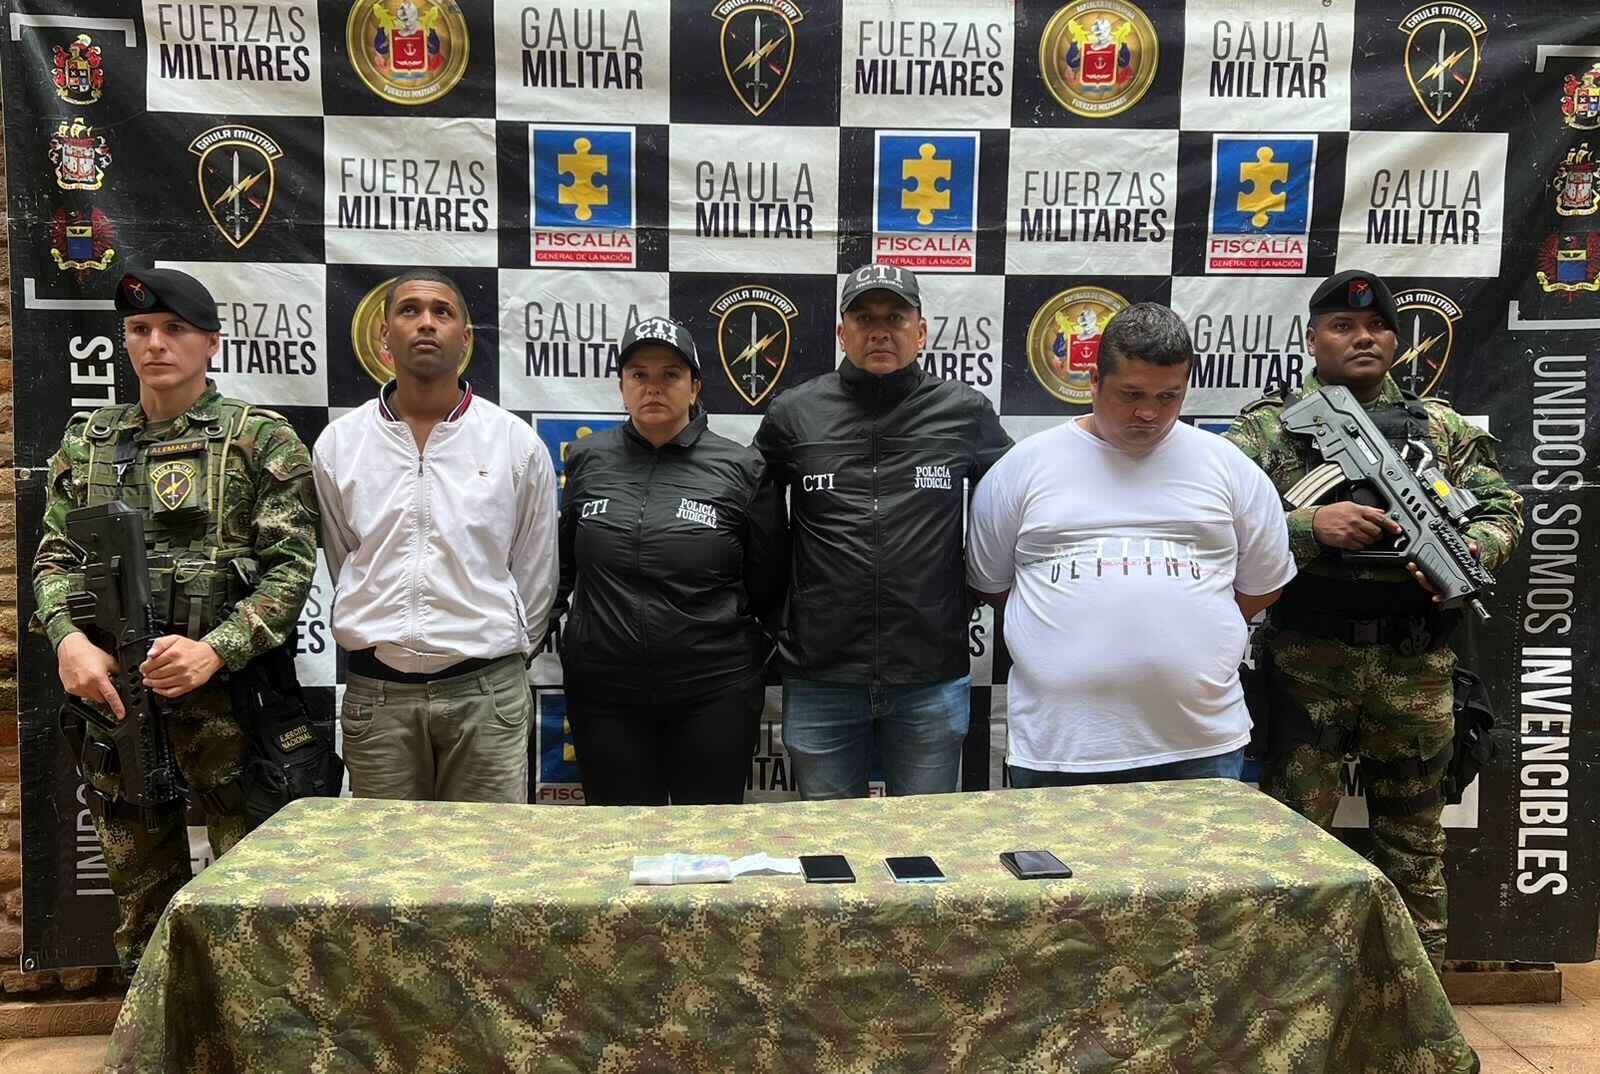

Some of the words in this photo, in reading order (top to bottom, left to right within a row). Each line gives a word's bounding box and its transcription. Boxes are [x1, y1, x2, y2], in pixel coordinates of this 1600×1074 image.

[159, 4, 306, 43] FUERZAS
[521, 6, 644, 51] GAULA
[1405, 6, 1440, 28] GAULA
[1441, 6, 1482, 30] MILITAR
[859, 20, 1003, 58] FUERZAS
[1213, 20, 1330, 62] GAULA
[160, 44, 311, 82] MILITARES
[522, 50, 644, 90] MILITAR
[855, 59, 1004, 97] MILITARES
[1209, 61, 1327, 98] MILITAR
[195, 129, 231, 150] GAULA
[233, 129, 277, 154] MILITAR
[341, 157, 486, 196] FUERZAS
[696, 160, 815, 203] GAULA
[1023, 170, 1166, 206] FUERZAS
[1371, 168, 1482, 209] GAULA
[338, 195, 489, 232] MILITARES
[695, 202, 814, 239] MILITAR
[1019, 208, 1167, 242] MILITARES
[1366, 209, 1480, 244] MILITAR
[535, 230, 631, 247] FISCALÍA
[877, 234, 971, 251] FISCALÍA
[1211, 236, 1303, 253] FISCALÍA
[856, 264, 904, 285] CTI
[879, 257, 914, 265] GENERAL
[916, 257, 927, 265] DE
[929, 257, 939, 265] LA
[716, 290, 750, 312] GAULA
[751, 289, 793, 314] MILITAR
[1394, 294, 1413, 306] ULA
[1415, 293, 1457, 316] MILITAR
[634, 318, 679, 339] CTI
[1193, 314, 1305, 353] GAULA
[206, 339, 317, 376] LITARES
[526, 342, 620, 378] MILITA
[1191, 354, 1304, 389] MILITAR
[1532, 355, 1587, 492] UNIDOS
[803, 473, 835, 492] CTI
[914, 477, 953, 490] JUDICIAL
[915, 464, 951, 478] POLICÍA
[581, 499, 610, 518] CTI
[676, 508, 717, 529] JUDICIAL
[680, 498, 717, 518] POLICÍA
[1524, 503, 1582, 634] SOMOS
[1516, 647, 1573, 896] INVENCIBLES
